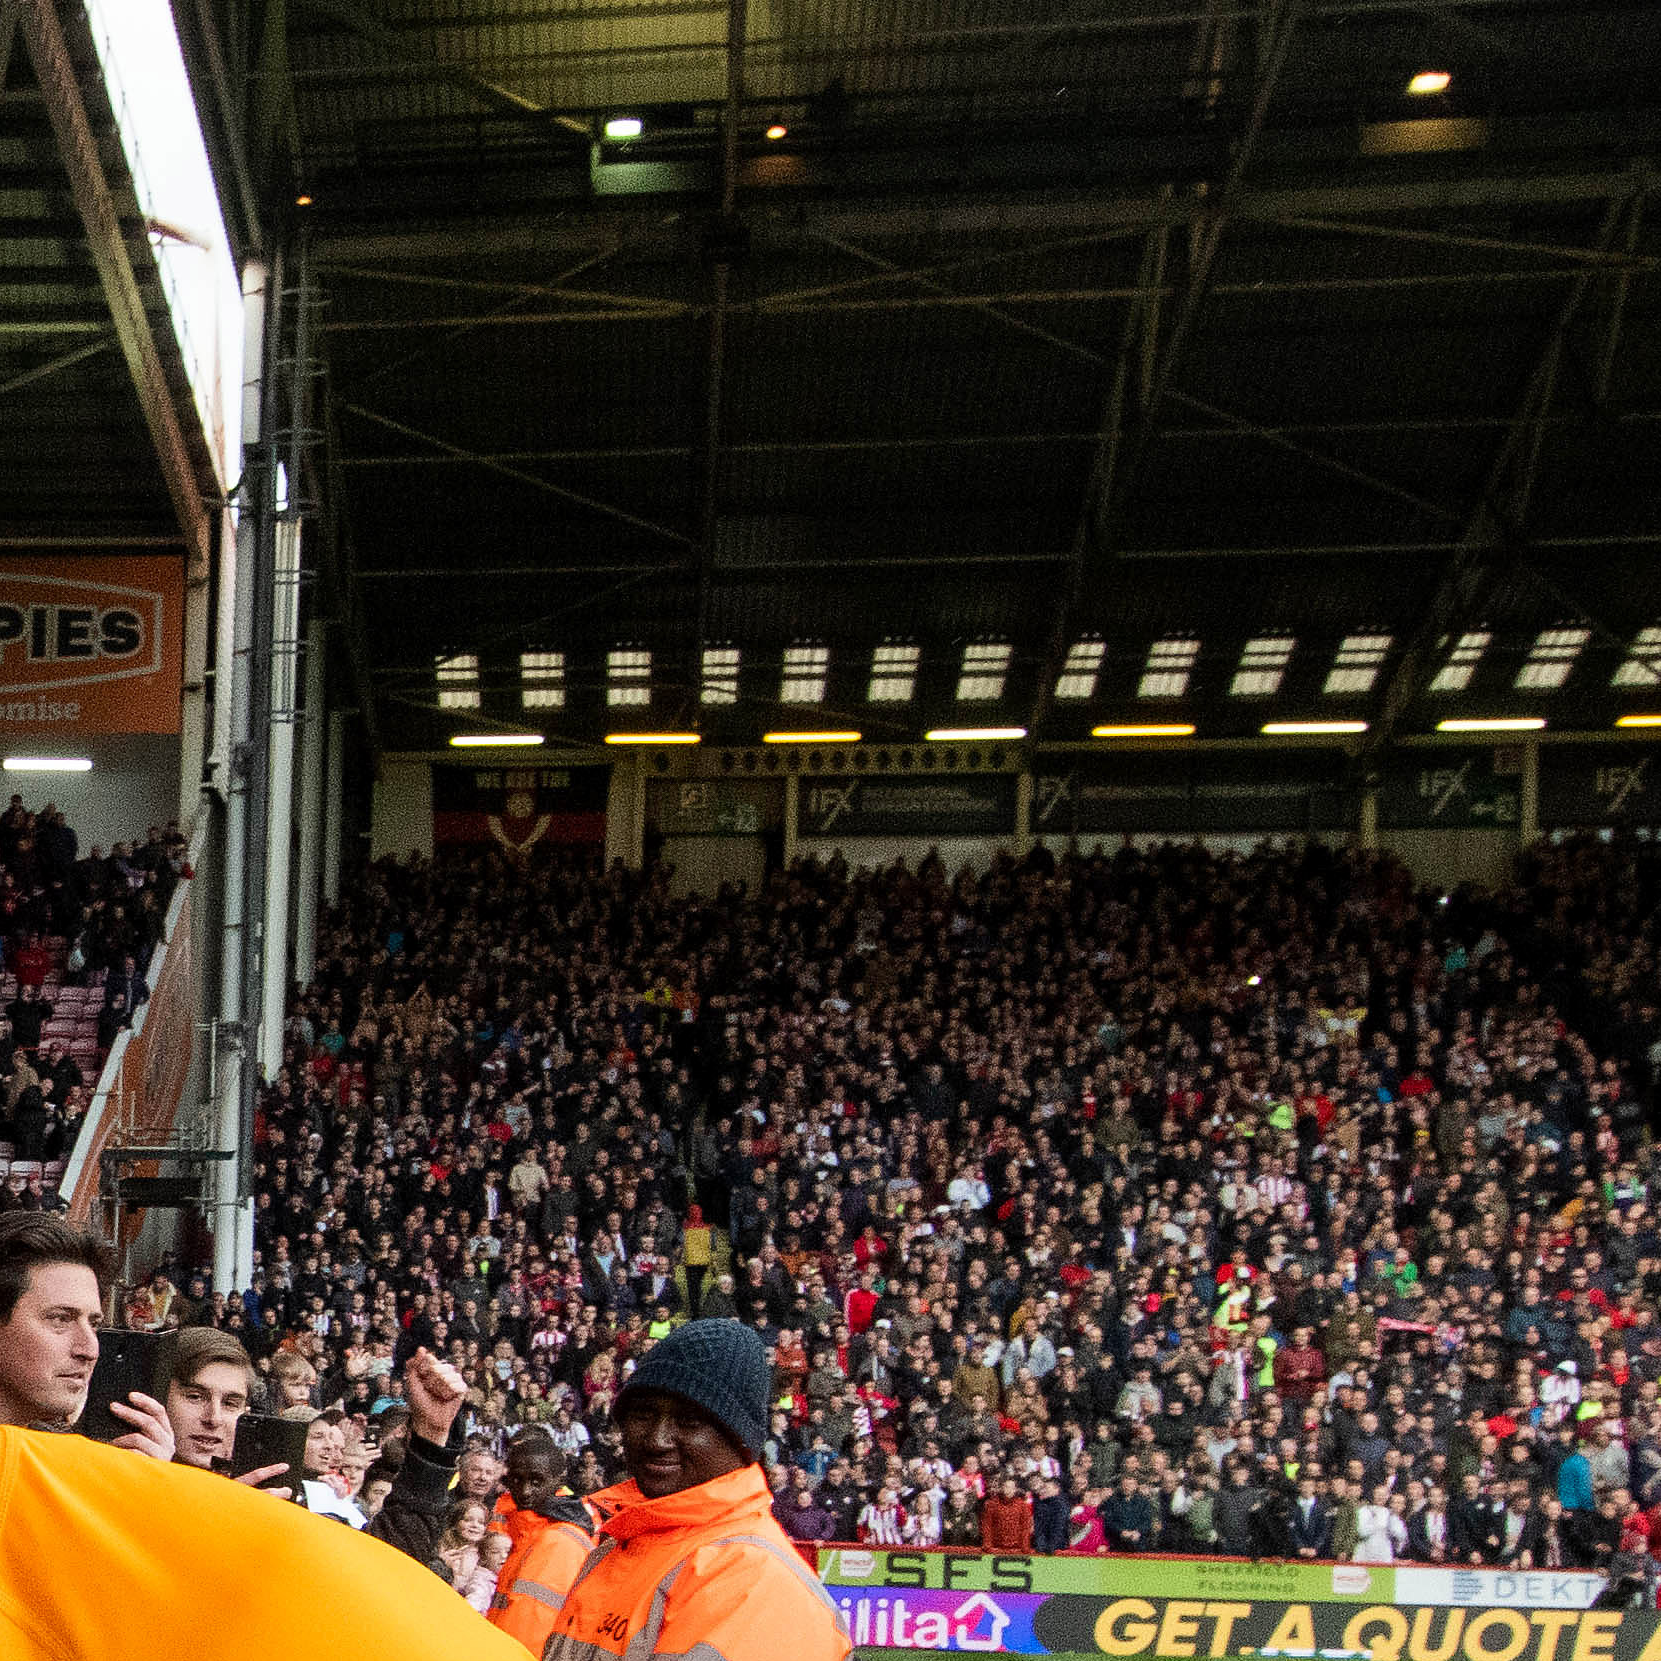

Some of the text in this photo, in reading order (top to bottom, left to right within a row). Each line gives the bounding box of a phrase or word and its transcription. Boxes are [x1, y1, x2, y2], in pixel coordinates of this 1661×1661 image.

[884, 1552, 1032, 1592] SFS
[1094, 1598, 1252, 1658] GET
[1264, 1604, 1316, 1652] A
